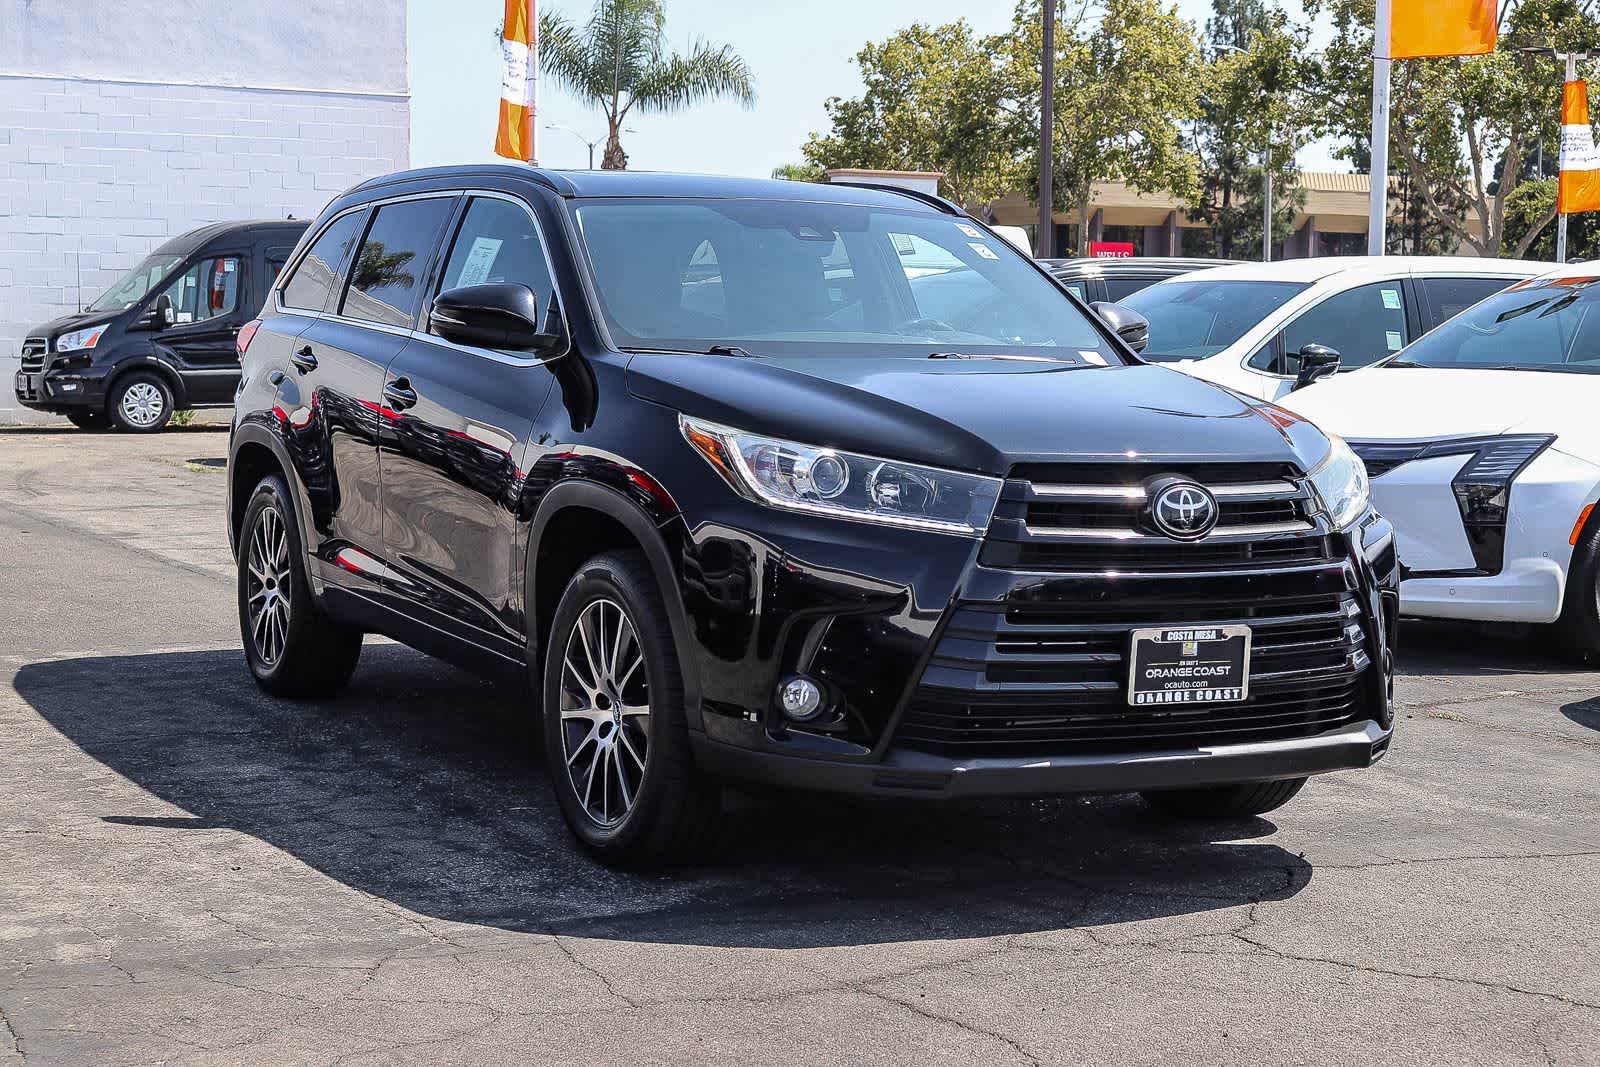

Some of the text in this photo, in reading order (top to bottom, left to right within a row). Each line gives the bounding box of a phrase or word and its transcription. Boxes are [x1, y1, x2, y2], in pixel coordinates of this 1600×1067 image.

[1167, 630, 1217, 641] COSTA MESA
[1164, 680, 1208, 689] ocauto.com
[1137, 689, 1240, 704] ORANGE COAST
